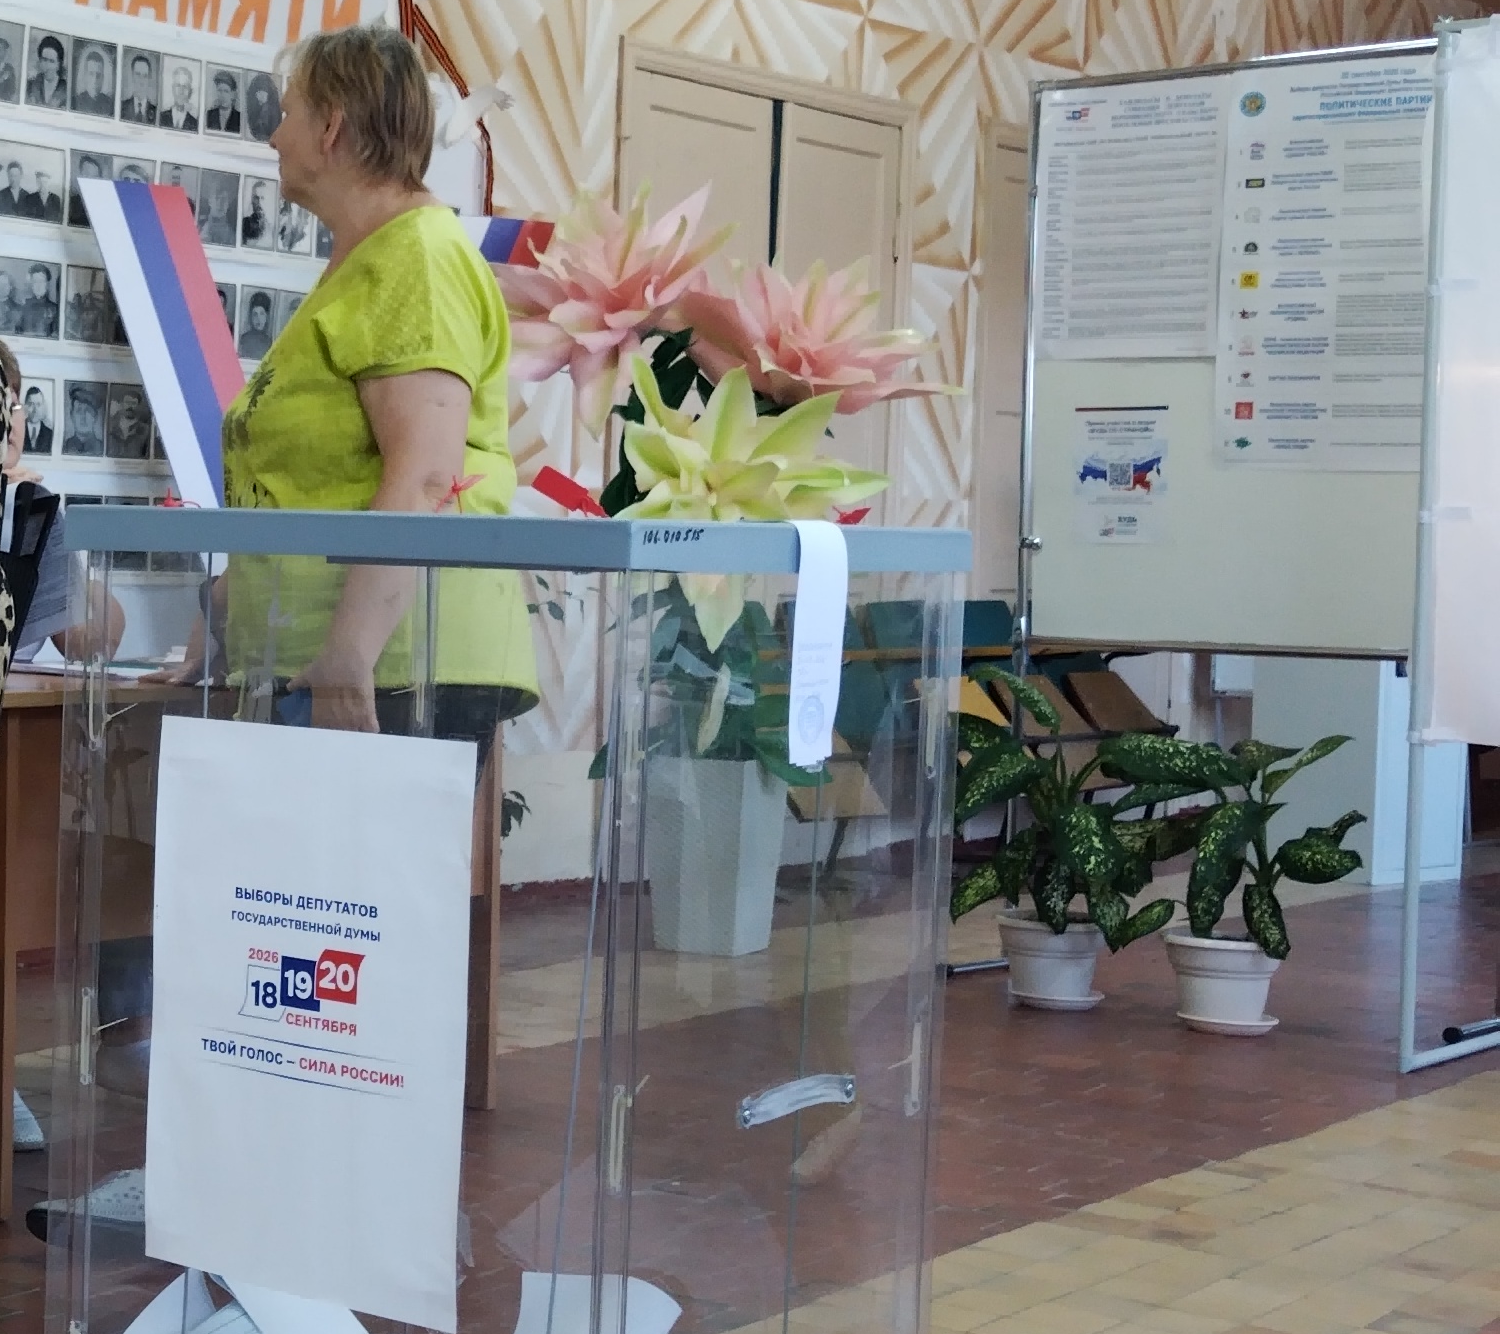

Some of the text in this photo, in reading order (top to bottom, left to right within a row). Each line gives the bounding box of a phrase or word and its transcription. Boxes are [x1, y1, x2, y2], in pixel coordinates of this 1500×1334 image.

[235, 886, 378, 918] ВЫБОРЫ ДЕПУТАТОВ
[231, 910, 381, 942] ГОСУДАРСТВЕННОЙ ДУМЫ
[248, 947, 279, 964] 2026
[251, 960, 356, 1009] 18 19 20
[285, 1013, 357, 1037] СЕНТЯБРЯ
[201, 1038, 236, 1057] ТВОЙ
[239, 1045, 283, 1065] ГОЛОС
[299, 1057, 337, 1076] СИЛА
[340, 1064, 405, 1088] РОССИИ!
